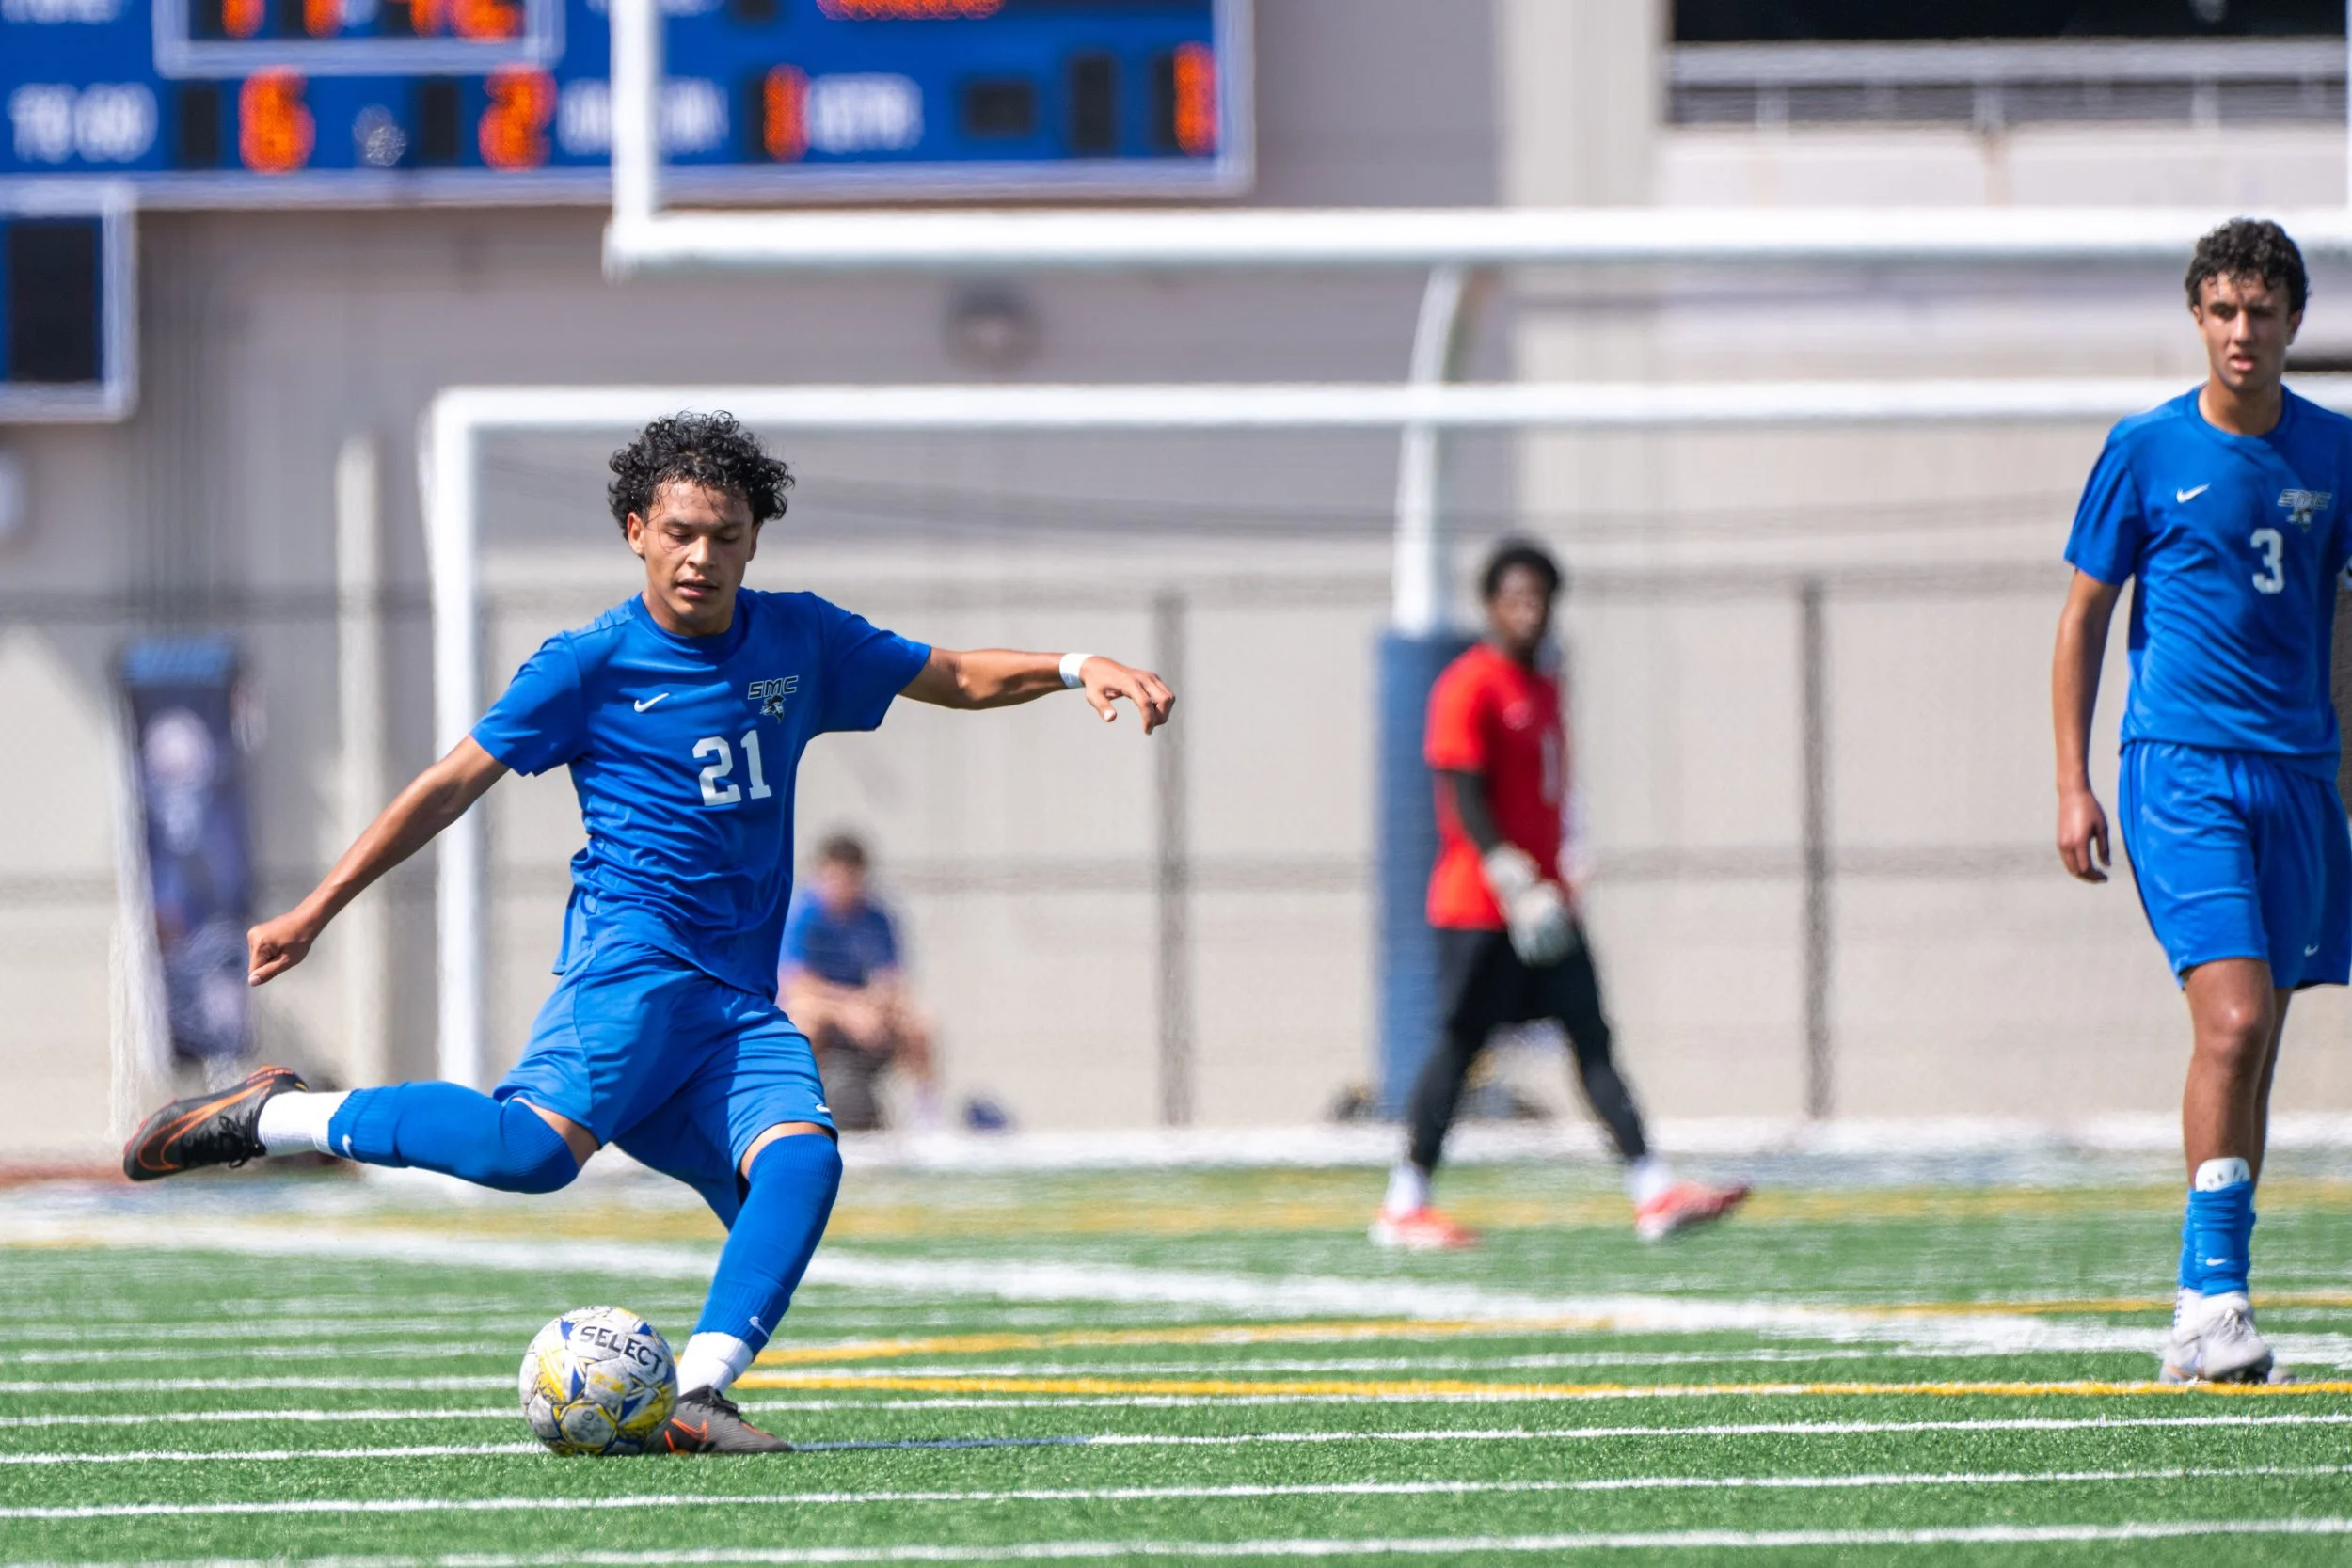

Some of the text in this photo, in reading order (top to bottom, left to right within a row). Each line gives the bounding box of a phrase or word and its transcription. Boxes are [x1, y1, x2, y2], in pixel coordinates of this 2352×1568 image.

[2249, 527, 2285, 594] 3
[747, 674, 800, 700] SMC
[691, 729, 772, 807] 21
[579, 1325, 664, 1375] SELECT
